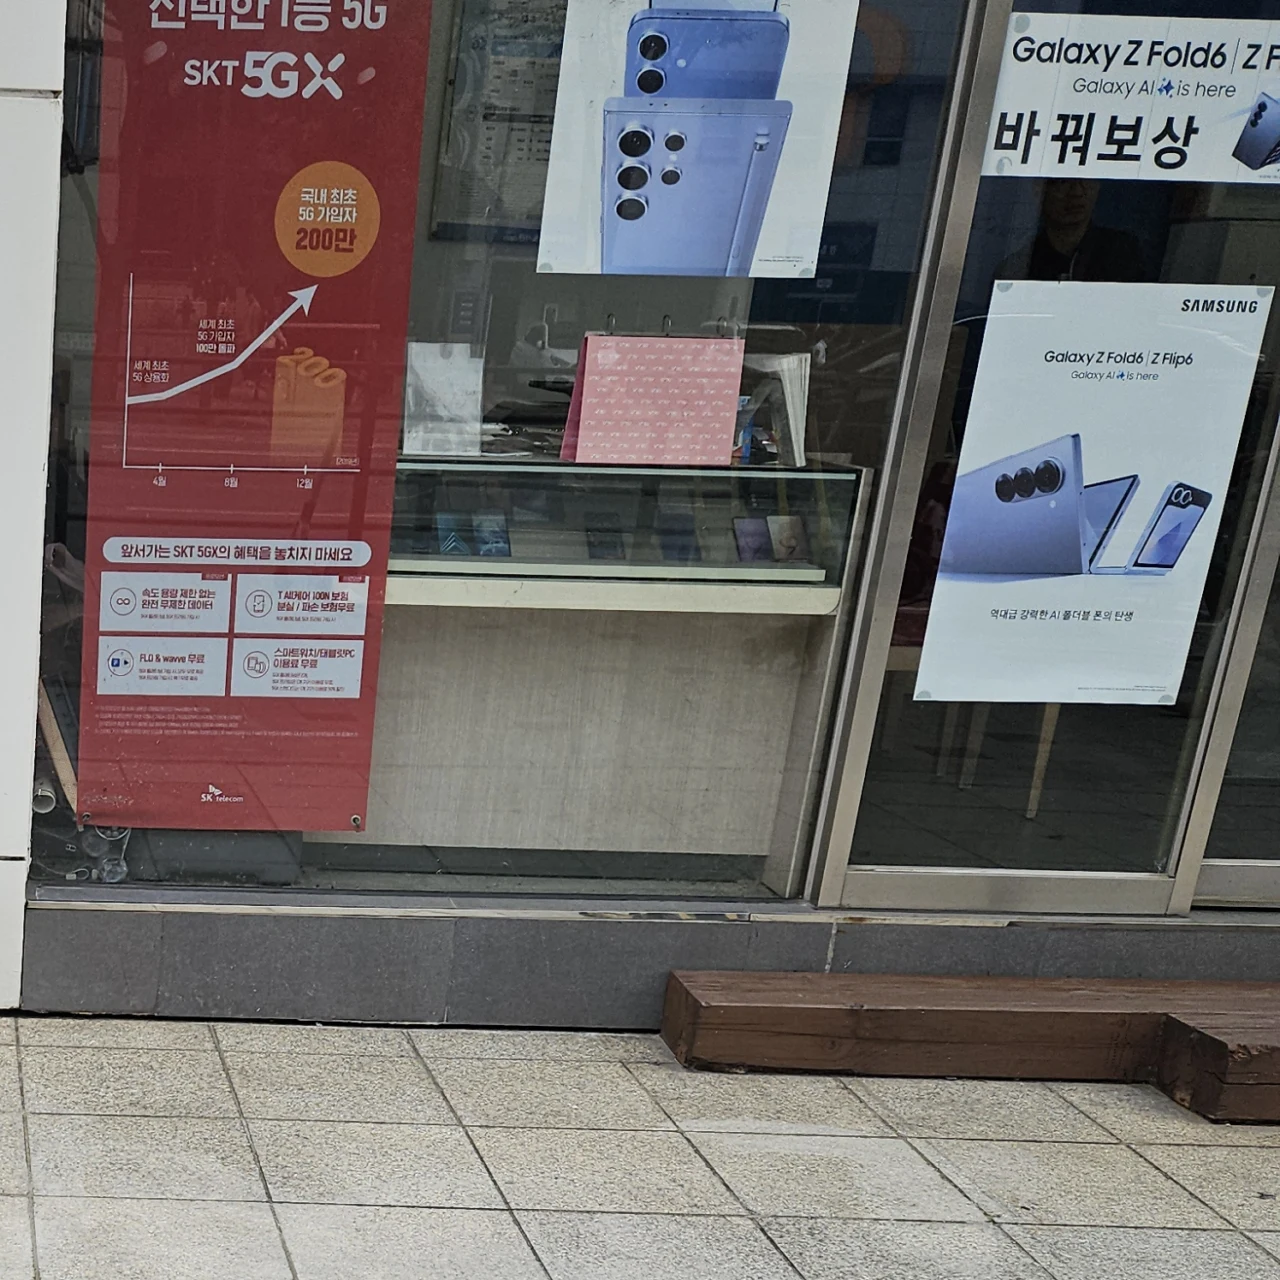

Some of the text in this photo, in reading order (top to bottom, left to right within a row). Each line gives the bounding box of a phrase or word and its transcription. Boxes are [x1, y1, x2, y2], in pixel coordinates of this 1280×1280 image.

[341, 0, 387, 30] 5G
[1012, 35, 1121, 72] Galaxy
[1123, 39, 1144, 66] Z
[1146, 41, 1227, 69] Fold6
[1241, 43, 1263, 70] Z
[183, 51, 346, 100] SKT 5GX
[1072, 77, 1236, 99] Galaxy AI is here
[300, 187, 358, 205] 국내 최초
[298, 206, 357, 223] 5G 가입자
[295, 227, 357, 253] 200만
[1181, 298, 1259, 314] SAMSUNG
[197, 331, 208, 341] 5G
[1044, 350, 1194, 369] Galaxy Z Fold6 Z Flip6
[1070, 370, 1105, 382] Galaxy
[1126, 371, 1134, 380] is
[1136, 371, 1160, 381] here
[121, 543, 353, 562] 앞서가는 SKT 5GX의 혜택을 놓치지 마세요
[990, 608, 1017, 620] 역대급
[1019, 609, 1048, 620] 강력한
[201, 793, 213, 802] SK
